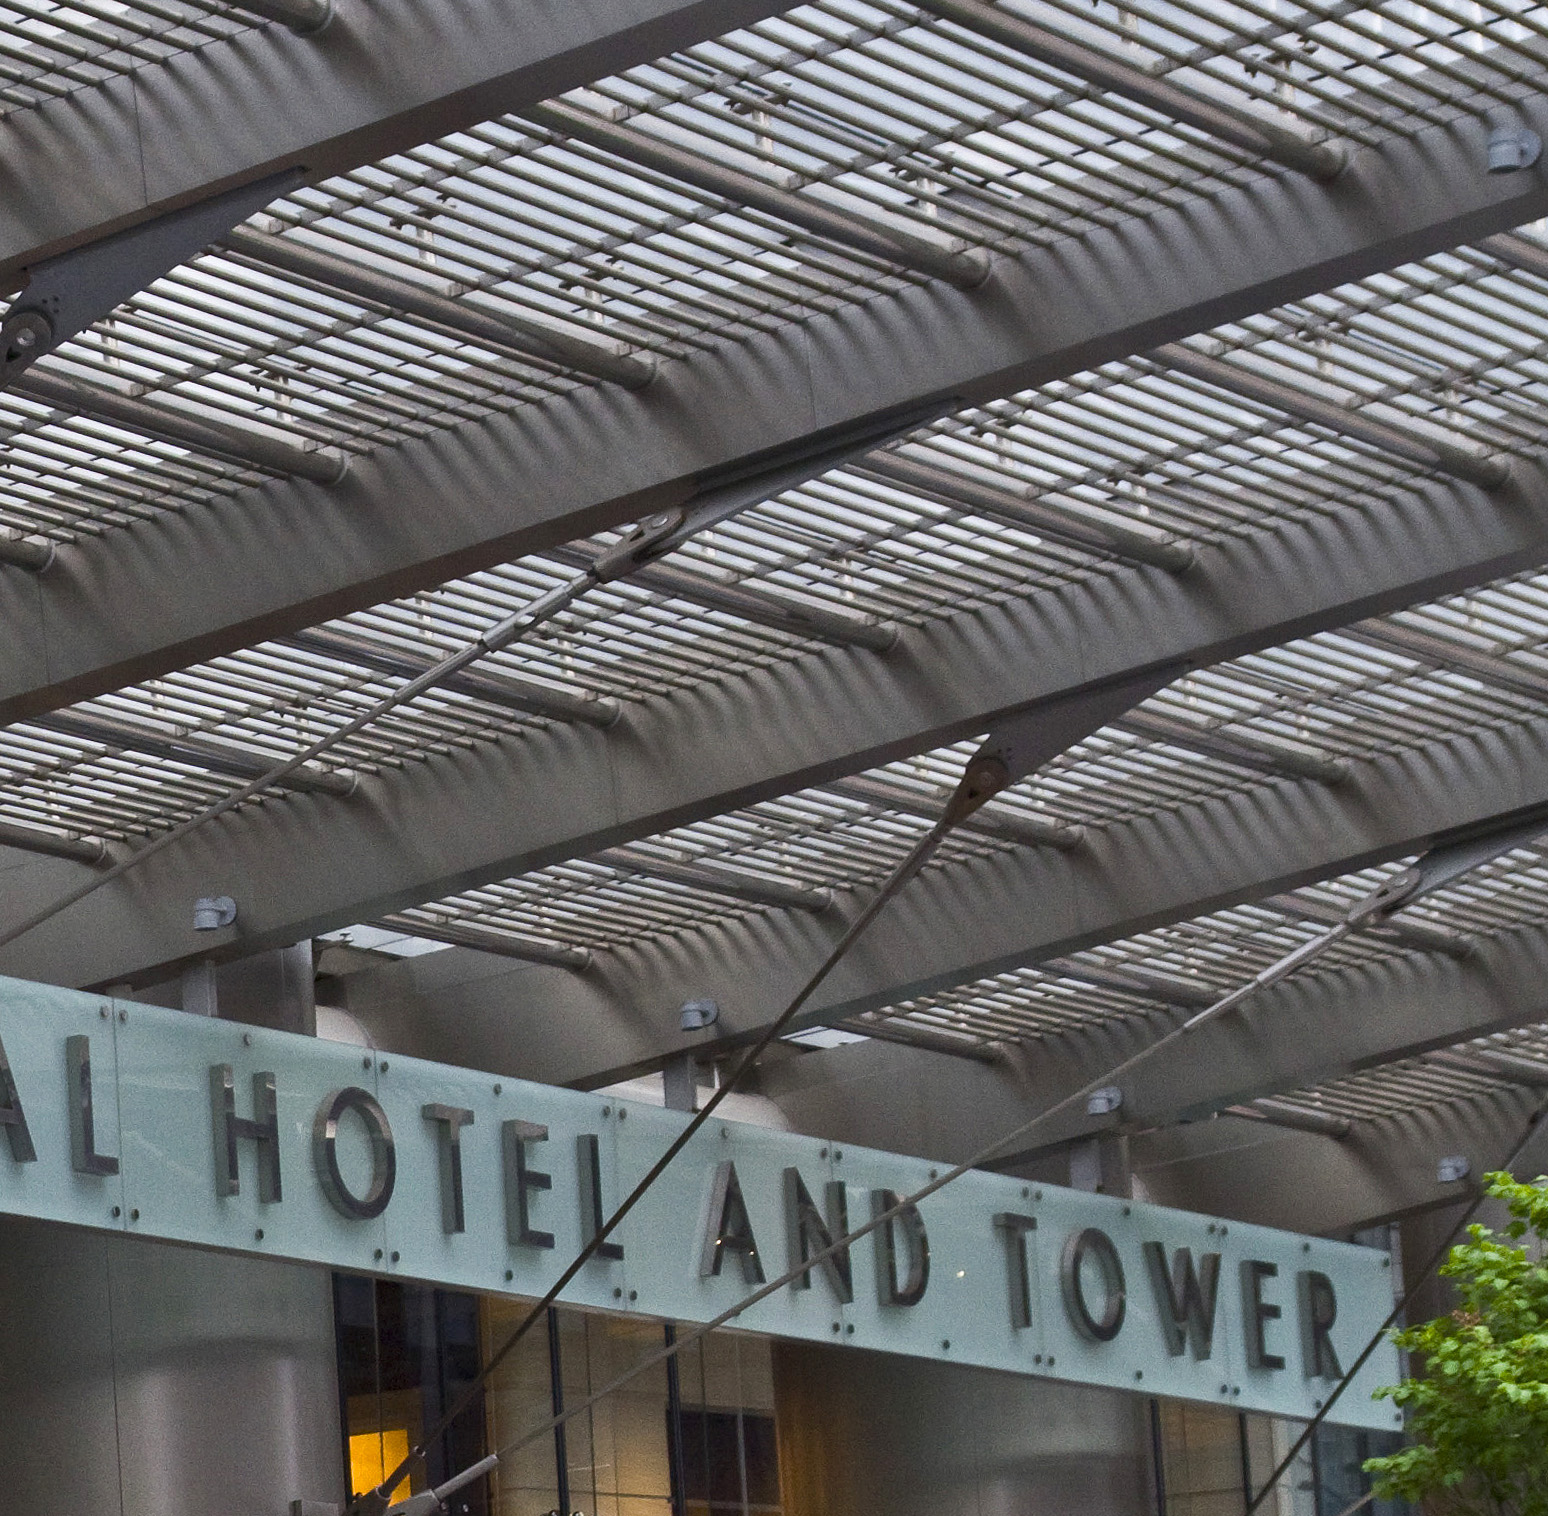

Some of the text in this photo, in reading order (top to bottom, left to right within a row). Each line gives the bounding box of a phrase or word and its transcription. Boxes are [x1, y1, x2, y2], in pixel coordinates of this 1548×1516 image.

[209, 1062, 624, 1262] HOTEL
[703, 1159, 931, 1308] AND
[992, 1211, 1344, 1381] TOWER
